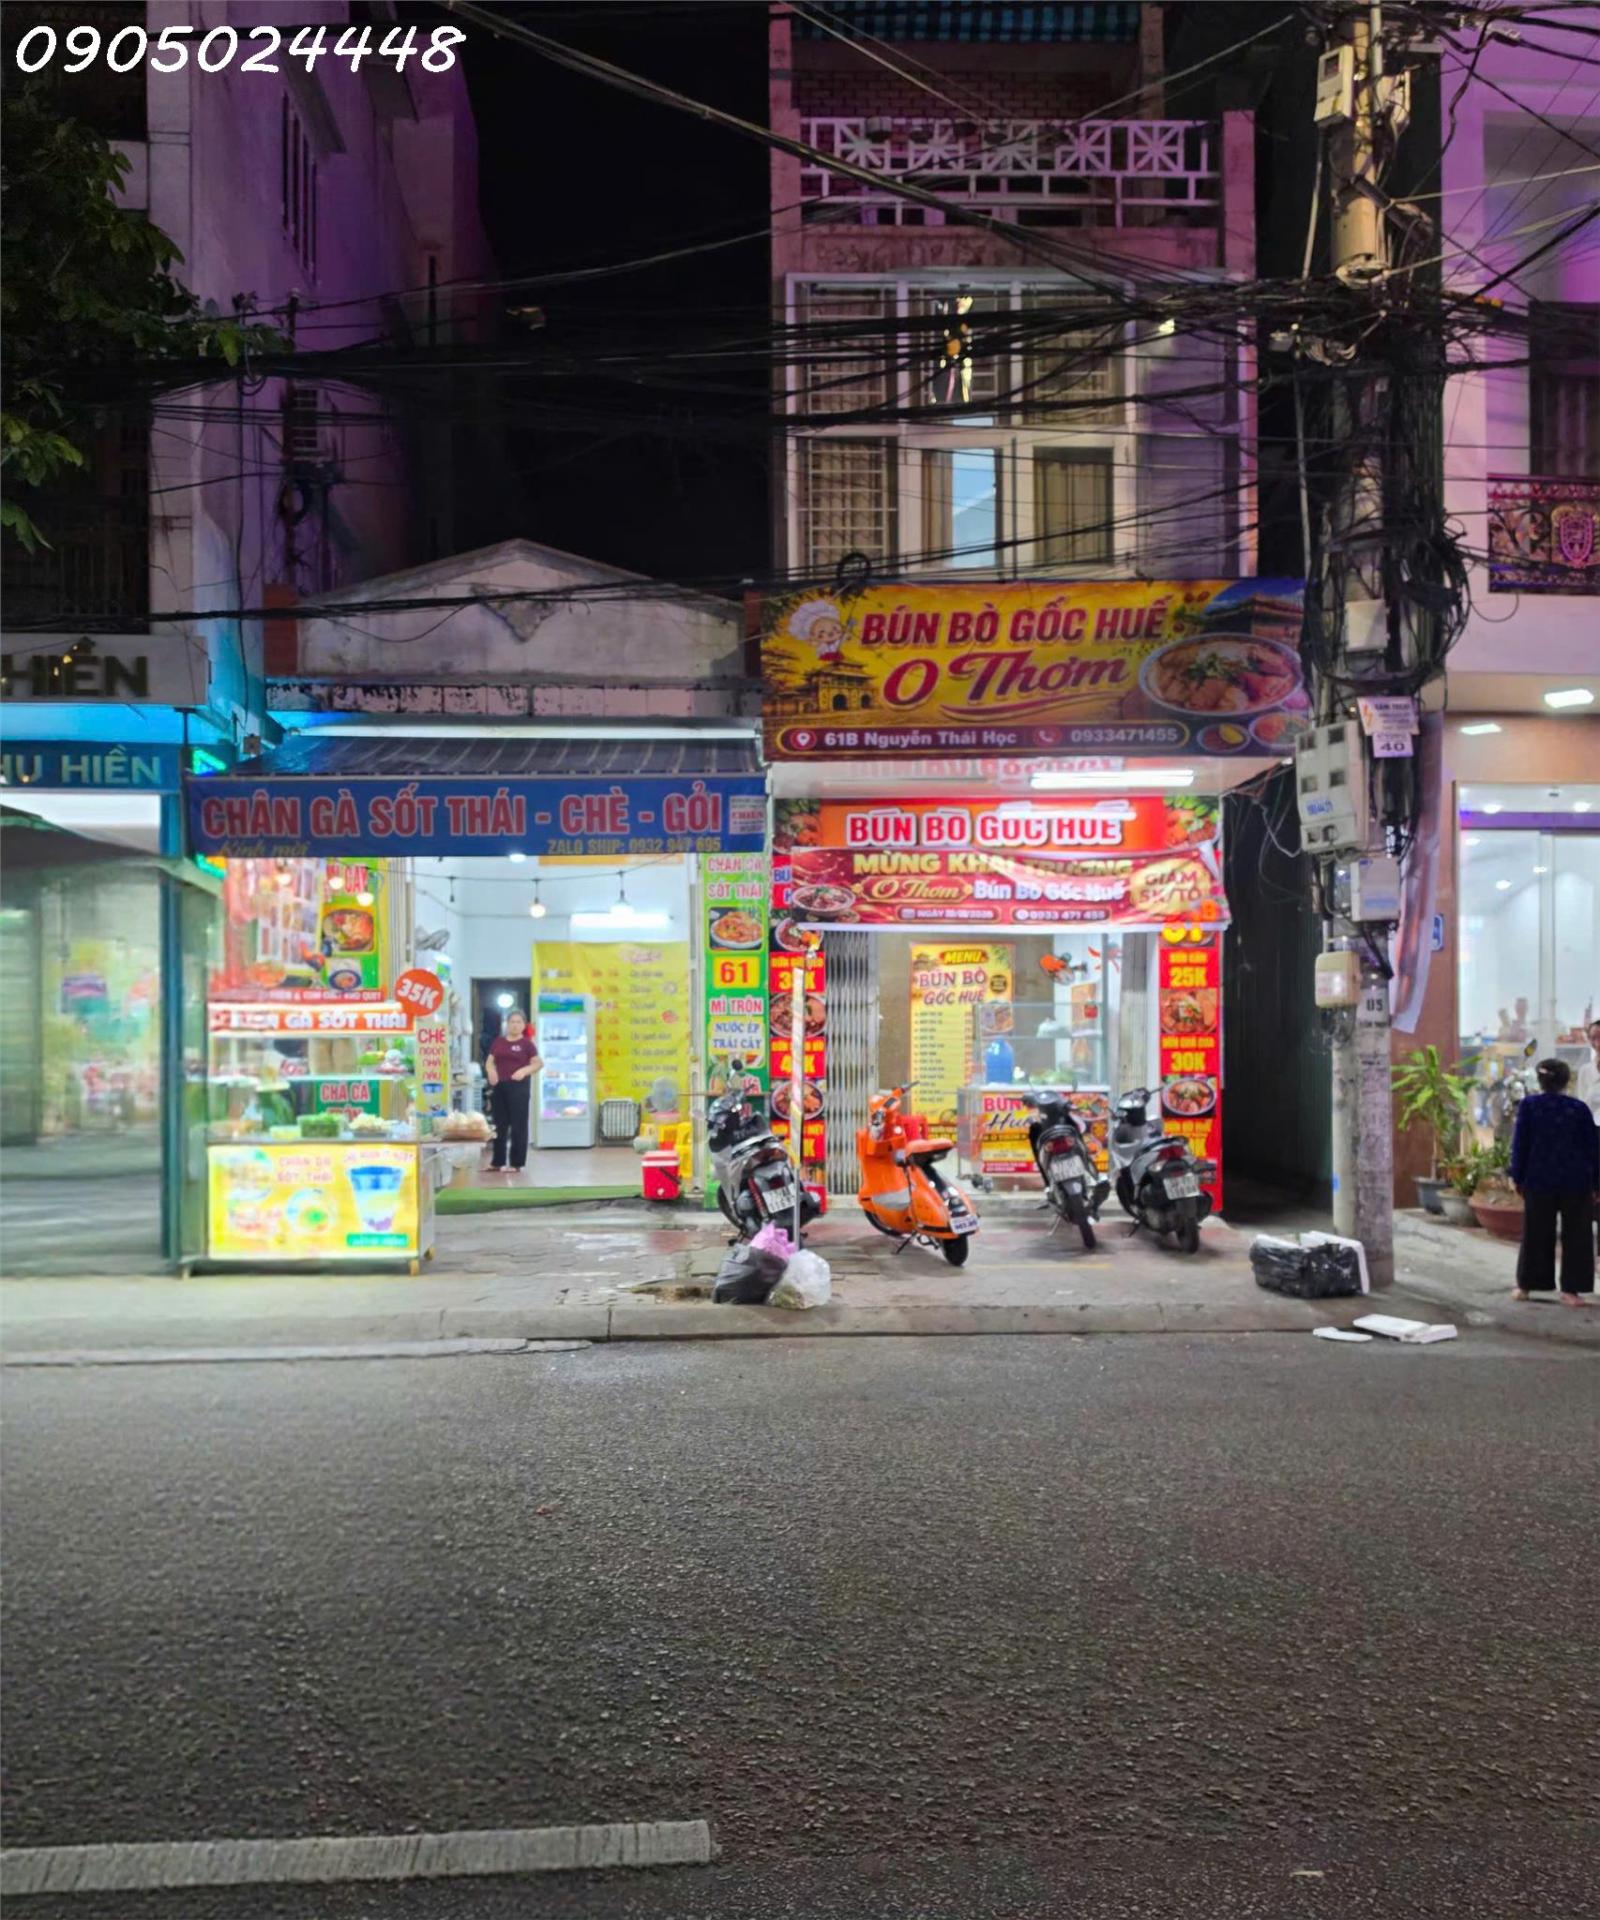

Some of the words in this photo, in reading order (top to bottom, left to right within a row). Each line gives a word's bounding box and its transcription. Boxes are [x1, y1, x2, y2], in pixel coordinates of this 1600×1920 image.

[861, 605, 941, 645] BÚN
[948, 603, 999, 643] BÒ
[1009, 596, 1087, 643] GỐC
[1094, 595, 1173, 641] HUẾ
[883, 658, 940, 706] O
[948, 650, 1130, 702] Thơm
[824, 732, 859, 746] 61B
[864, 730, 933, 748] Nguyễn
[937, 730, 976, 745] Thái
[982, 730, 1017, 747] Học
[1070, 728, 1178, 743] 0933471455
[61, 744, 161, 784] HIỀN
[202, 789, 300, 838] CHÂN
[310, 788, 360, 837] GÀ
[369, 782, 437, 837] SỐT
[445, 786, 526, 836] THÁI
[560, 786, 630, 835] CHÈ
[663, 780, 722, 834] GỎI
[720, 960, 749, 985] 61
[778, 970, 816, 991] 3K
